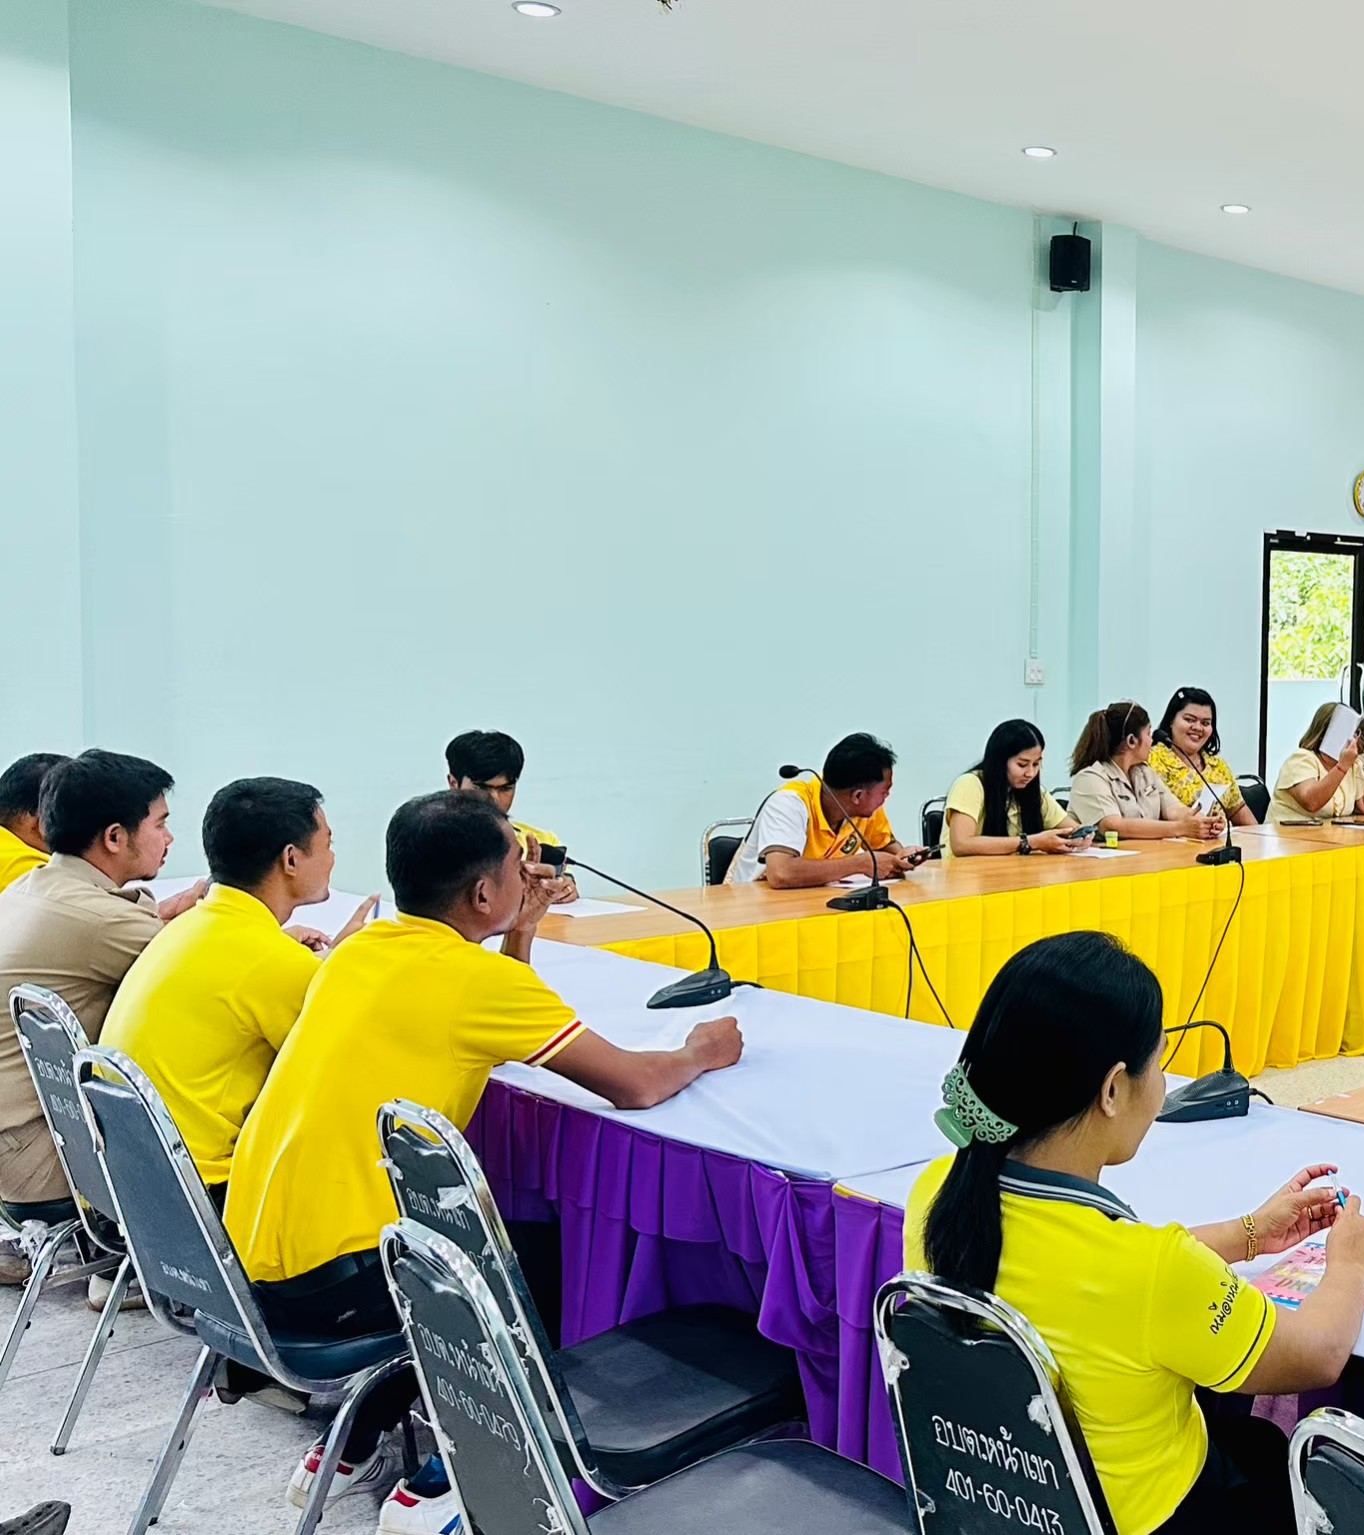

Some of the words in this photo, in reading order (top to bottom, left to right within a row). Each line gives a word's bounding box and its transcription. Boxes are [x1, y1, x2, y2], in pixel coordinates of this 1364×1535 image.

[931, 1415, 1060, 1490] อบต.หน้าเขา
[945, 1467, 1065, 1535] 401-60-0413
